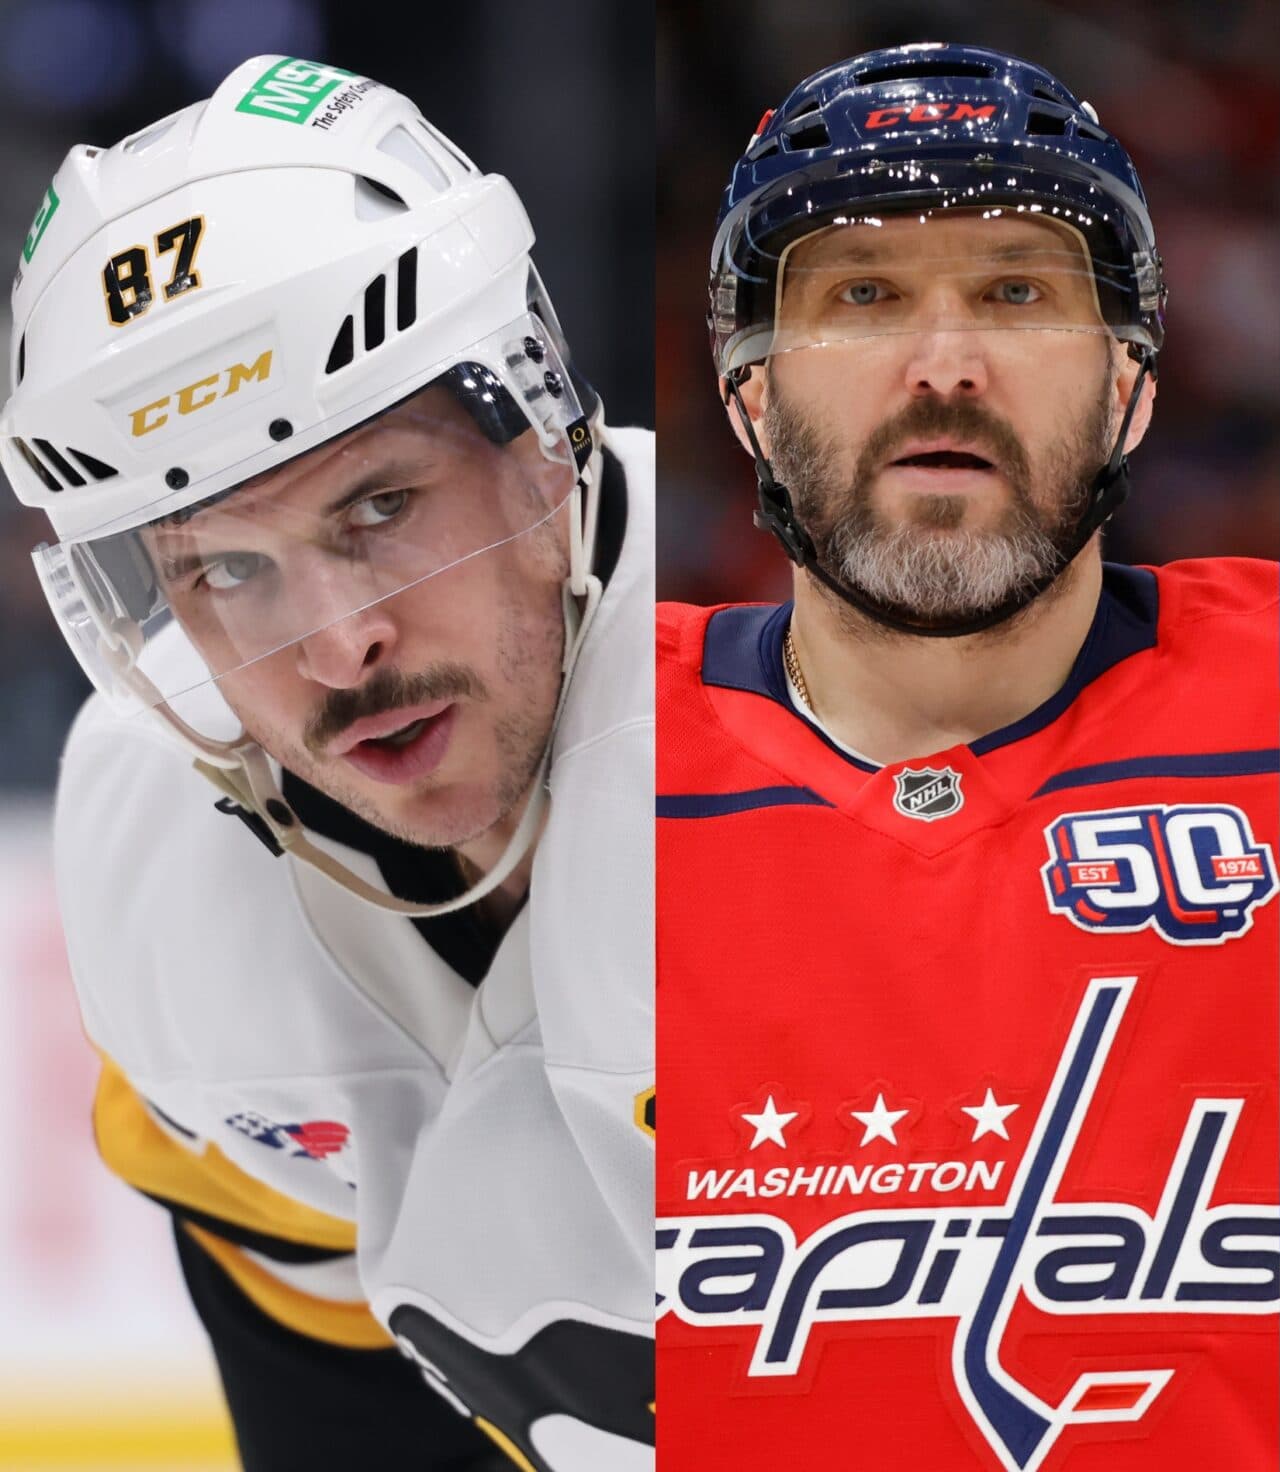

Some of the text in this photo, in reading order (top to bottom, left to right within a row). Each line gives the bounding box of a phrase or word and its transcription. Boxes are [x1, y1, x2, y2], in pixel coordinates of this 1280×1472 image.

[312, 111, 338, 130] The
[864, 103, 997, 129] CCM
[102, 213, 205, 327] 87
[128, 350, 272, 437] CCM
[909, 781, 949, 810] NHL
[1072, 813, 1256, 908] 50
[1078, 867, 1109, 881] EST
[1218, 860, 1259, 875] 1974
[686, 1161, 1006, 1200] WASHINGTON
